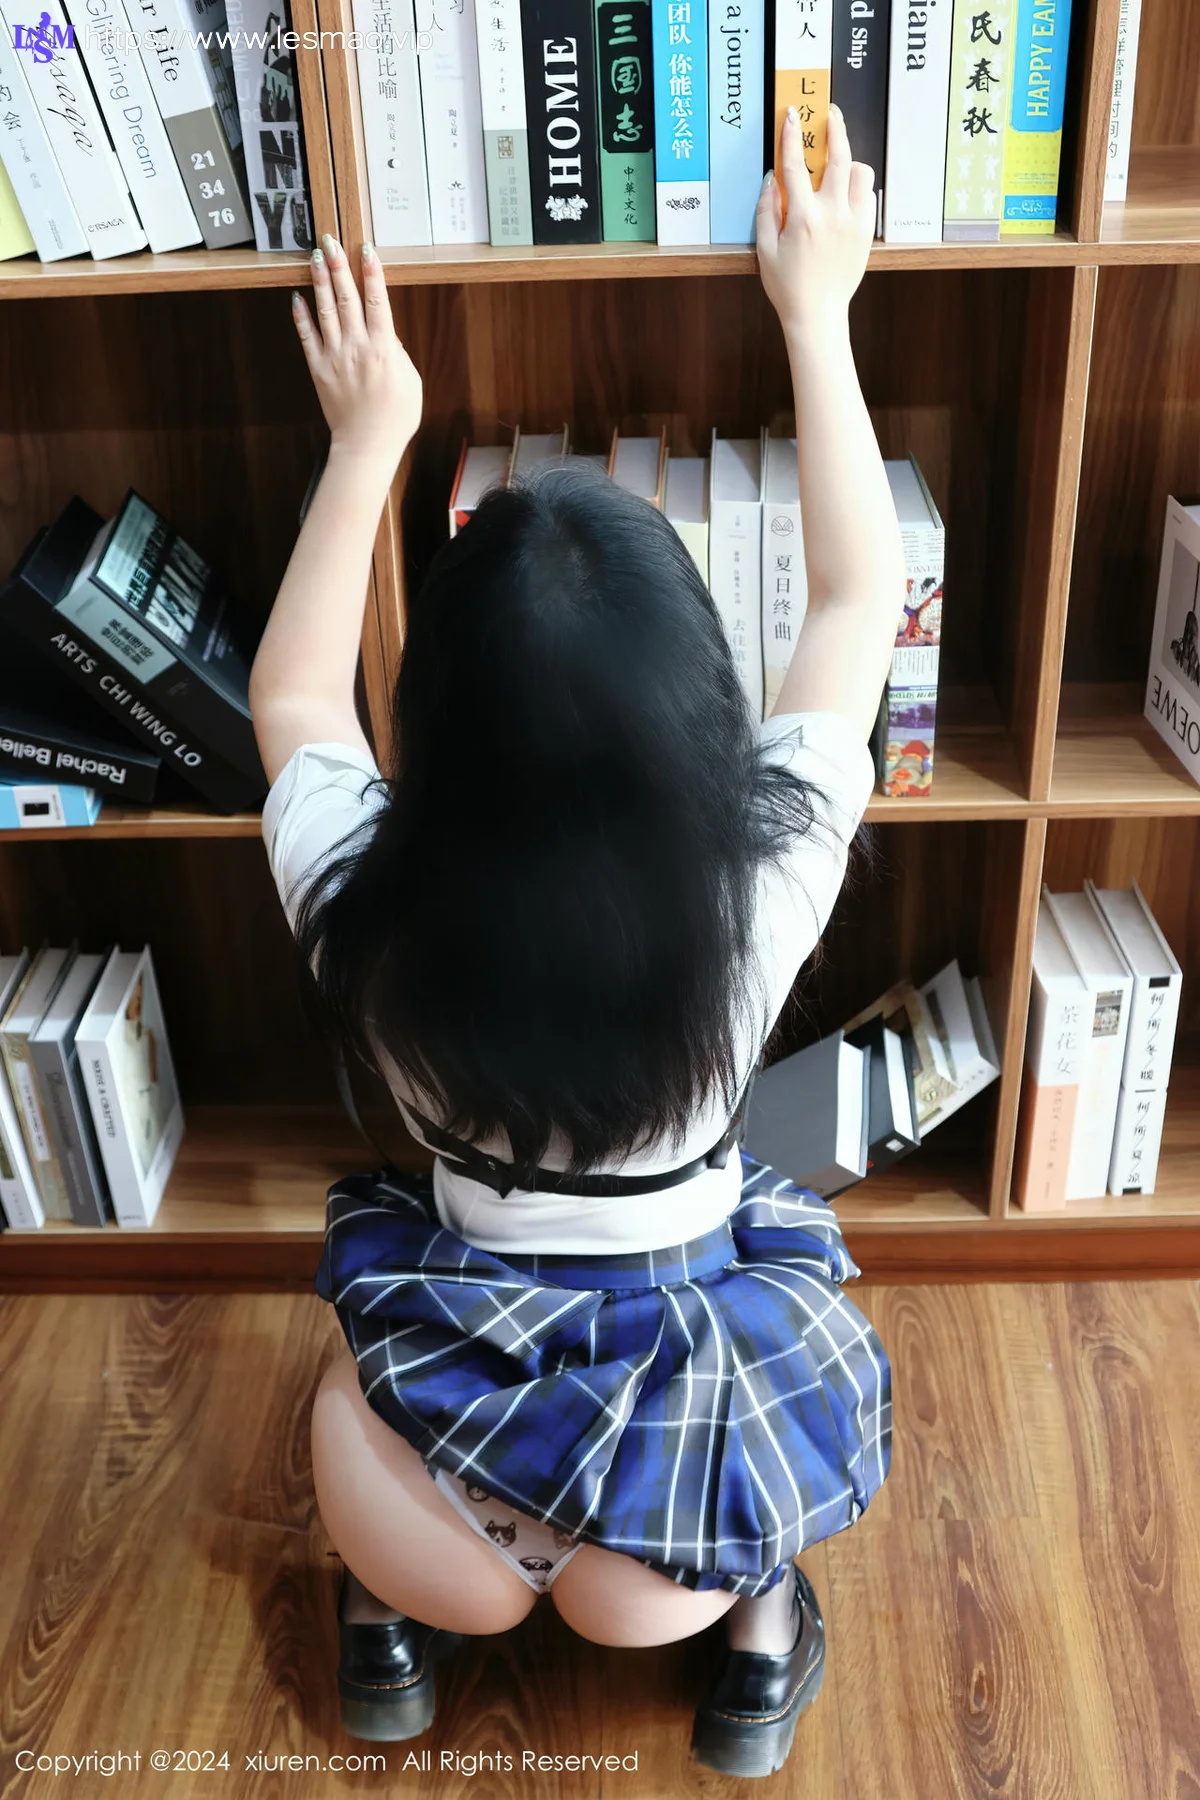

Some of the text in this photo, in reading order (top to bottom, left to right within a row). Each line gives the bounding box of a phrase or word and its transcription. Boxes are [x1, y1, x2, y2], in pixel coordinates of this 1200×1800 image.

[156, 25, 179, 83] Life
[608, 13, 643, 143] 三国志
[720, 5, 749, 129] a journey
[847, 27, 867, 69] Ship
[963, 11, 1002, 138] 氏春秋
[1026, 44, 1053, 117] HAPPY
[123, 105, 157, 180] Dream
[543, 36, 583, 188] HOME
[668, 54, 693, 159] 你能怎么管
[191, 150, 215, 170] 21
[200, 179, 225, 199] 34
[208, 207, 235, 228] 76
[773, 554, 792, 641] 夏日终曲
[50, 632, 98, 674] ARTS
[99, 674, 133, 705] CHI
[130, 701, 177, 746] WING
[173, 746, 202, 768] LO
[0, 736, 127, 784] Rachel Belle
